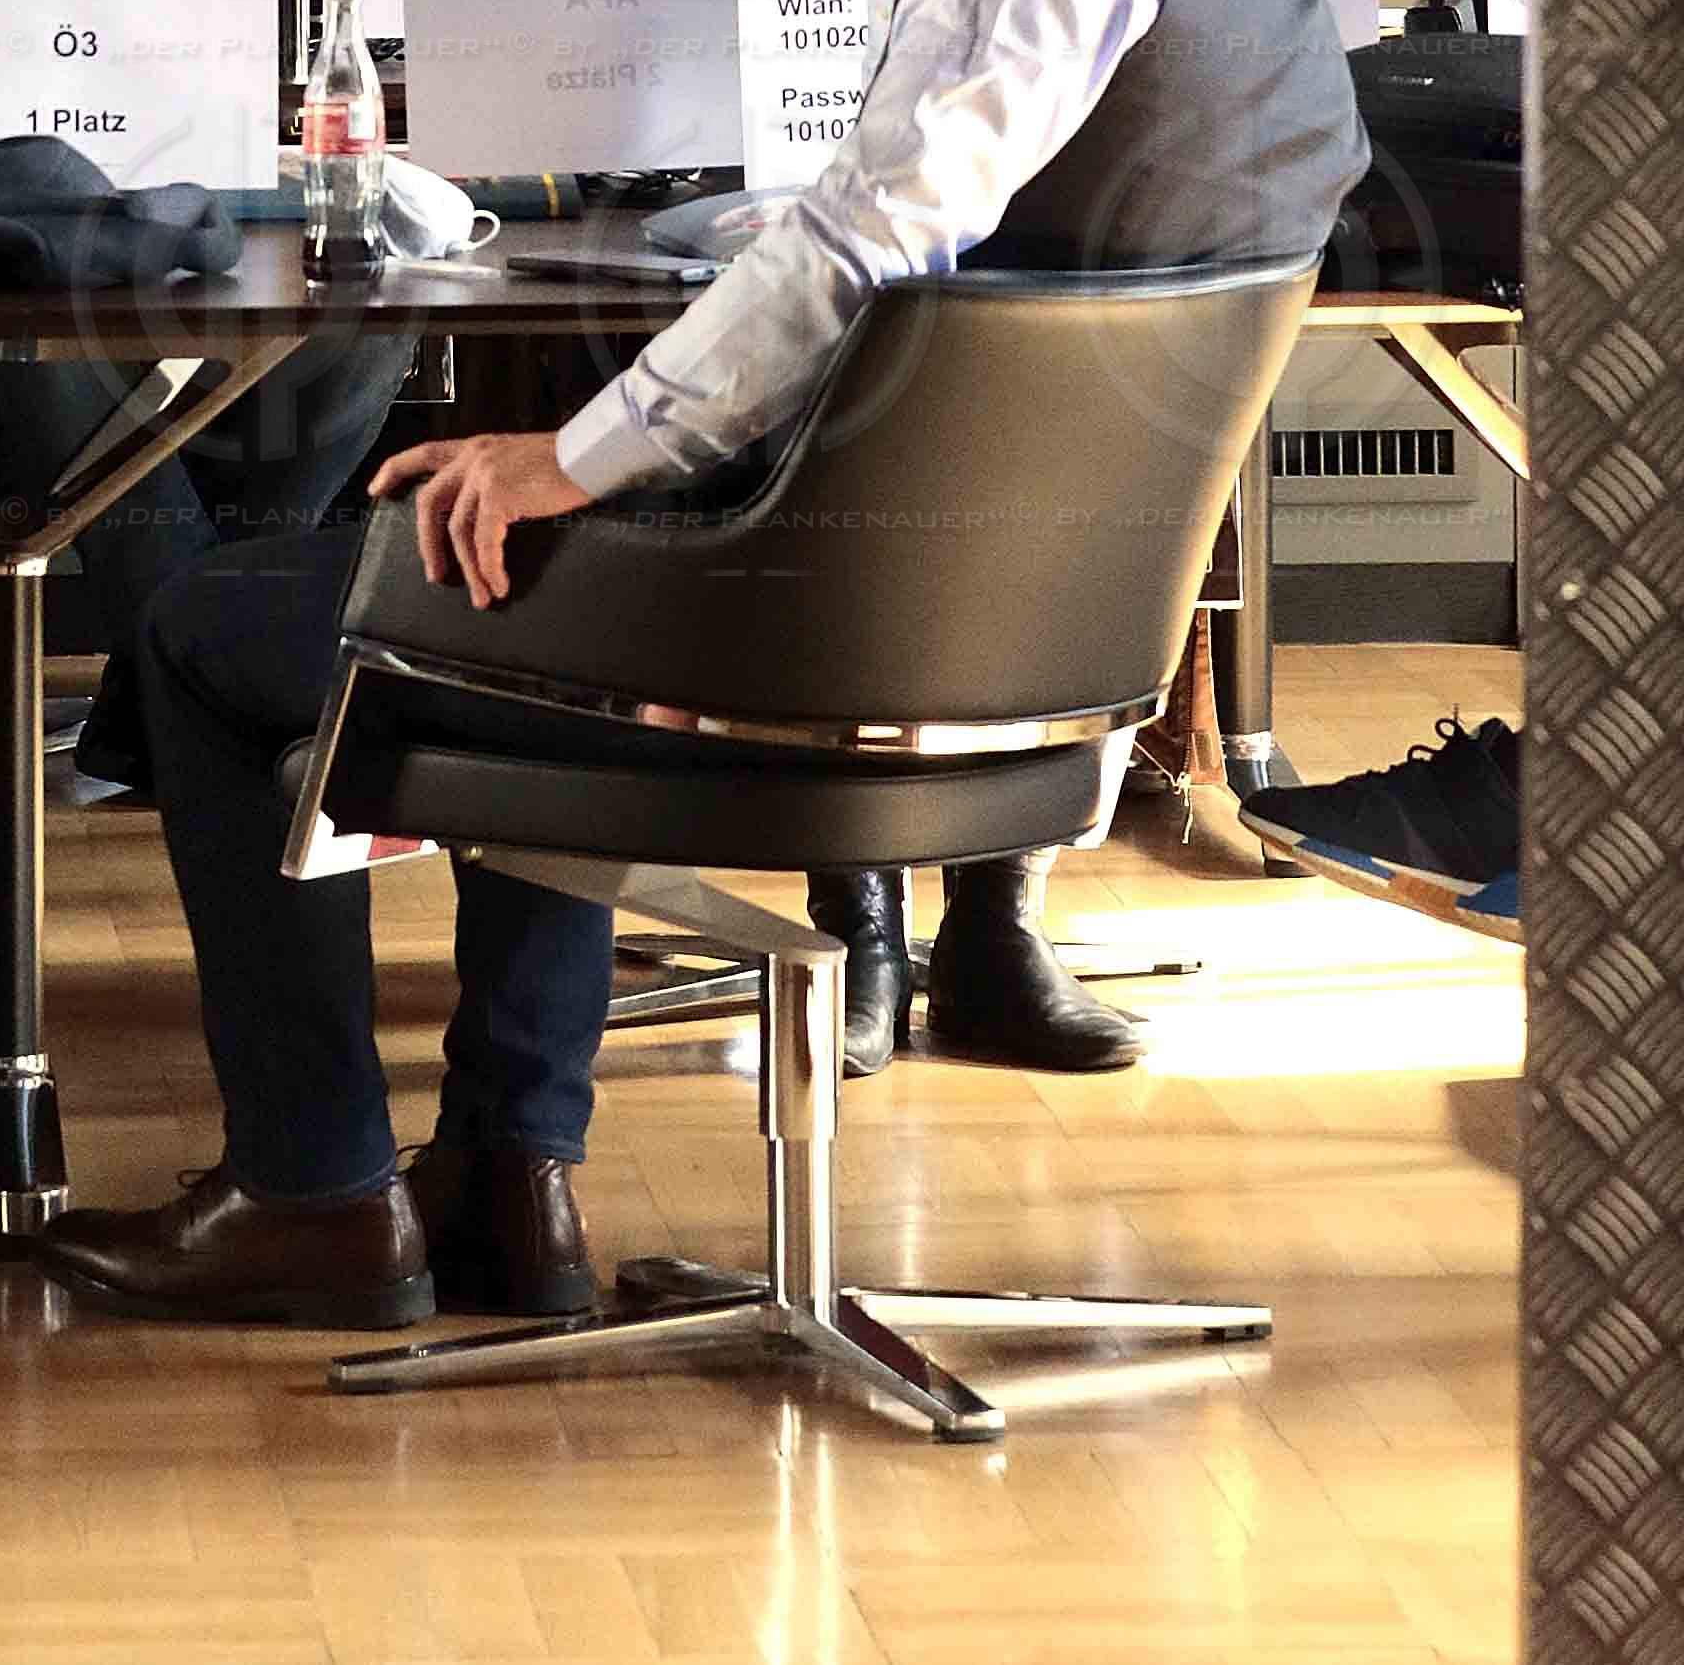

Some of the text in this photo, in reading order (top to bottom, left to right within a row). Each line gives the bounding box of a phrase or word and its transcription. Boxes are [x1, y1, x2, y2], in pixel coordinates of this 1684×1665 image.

[54, 24, 98, 57] Ö3
[27, 110, 126, 132] 1 Platz
